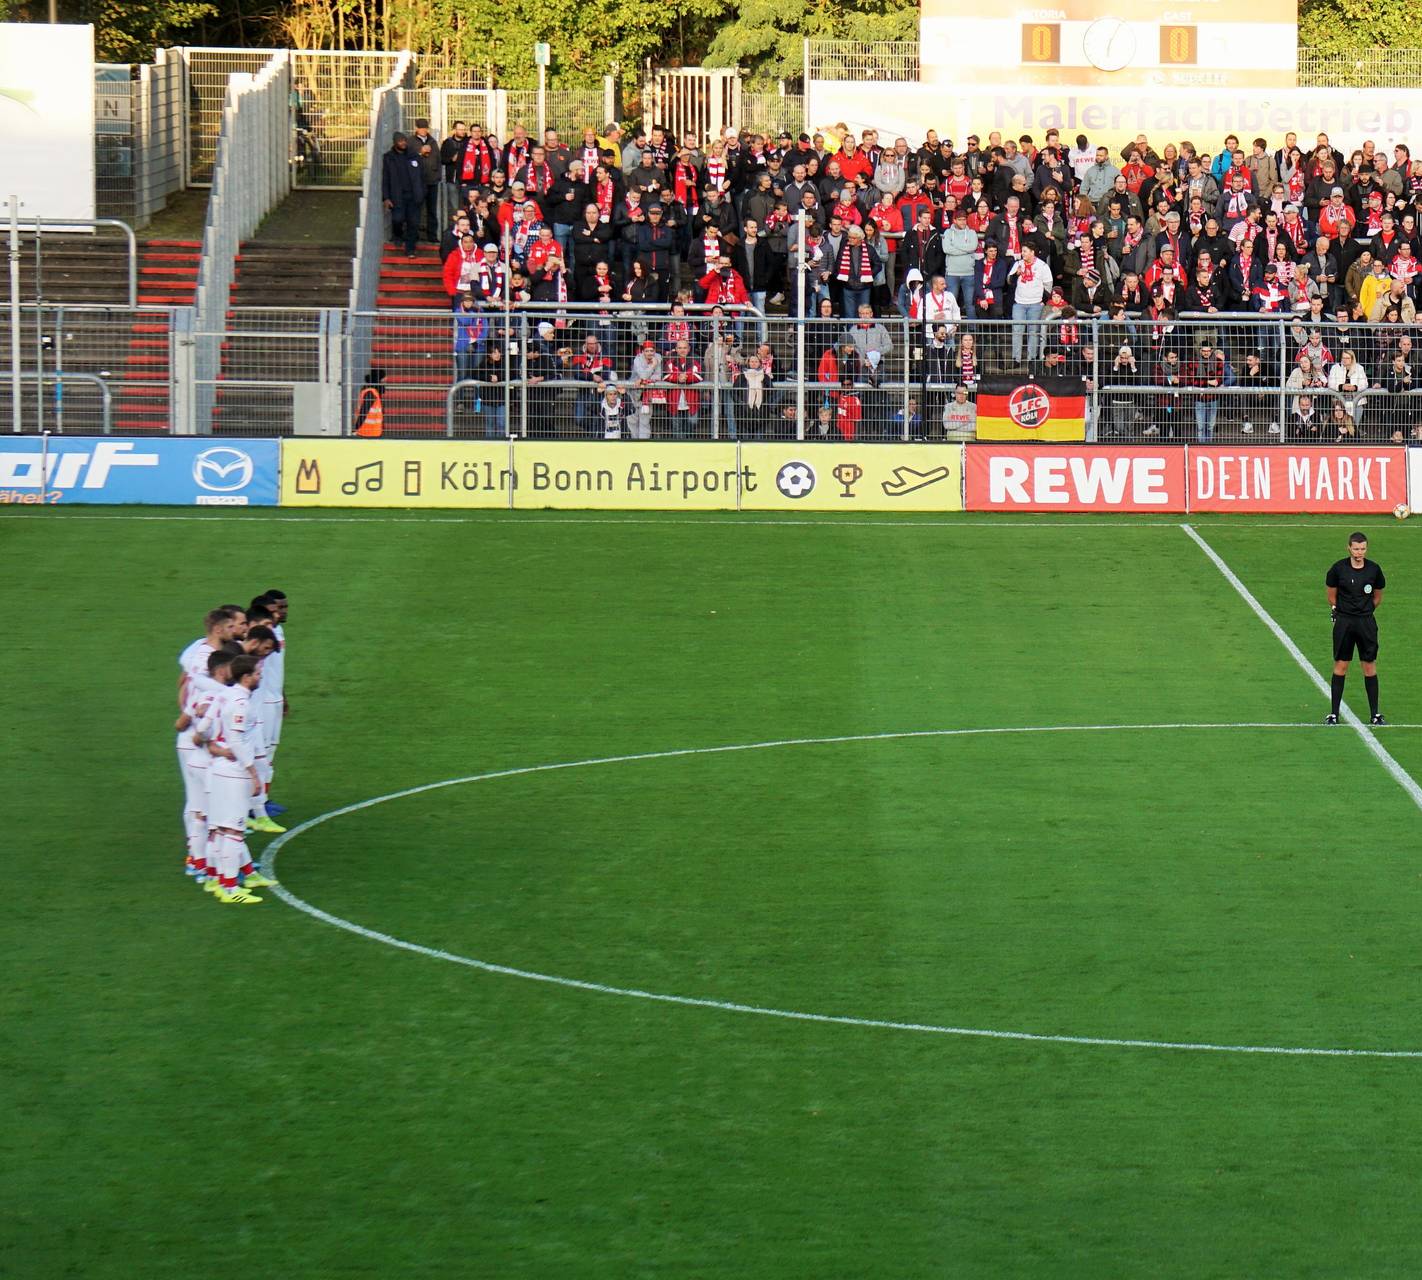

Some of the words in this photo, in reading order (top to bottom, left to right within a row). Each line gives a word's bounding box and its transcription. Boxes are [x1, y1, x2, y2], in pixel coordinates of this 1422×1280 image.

[1032, 26, 1051, 60] 0
[1170, 28, 1188, 62] 0
[994, 97, 1413, 133] Malerfachbetrieb
[1016, 398, 1042, 413] 1.FC
[441, 461, 518, 491] Köln
[533, 462, 613, 491] Bonn
[627, 462, 758, 499] Airport
[989, 456, 1169, 505] REWE
[1196, 455, 1271, 501] DEIN
[1288, 456, 1391, 502] MARKT
